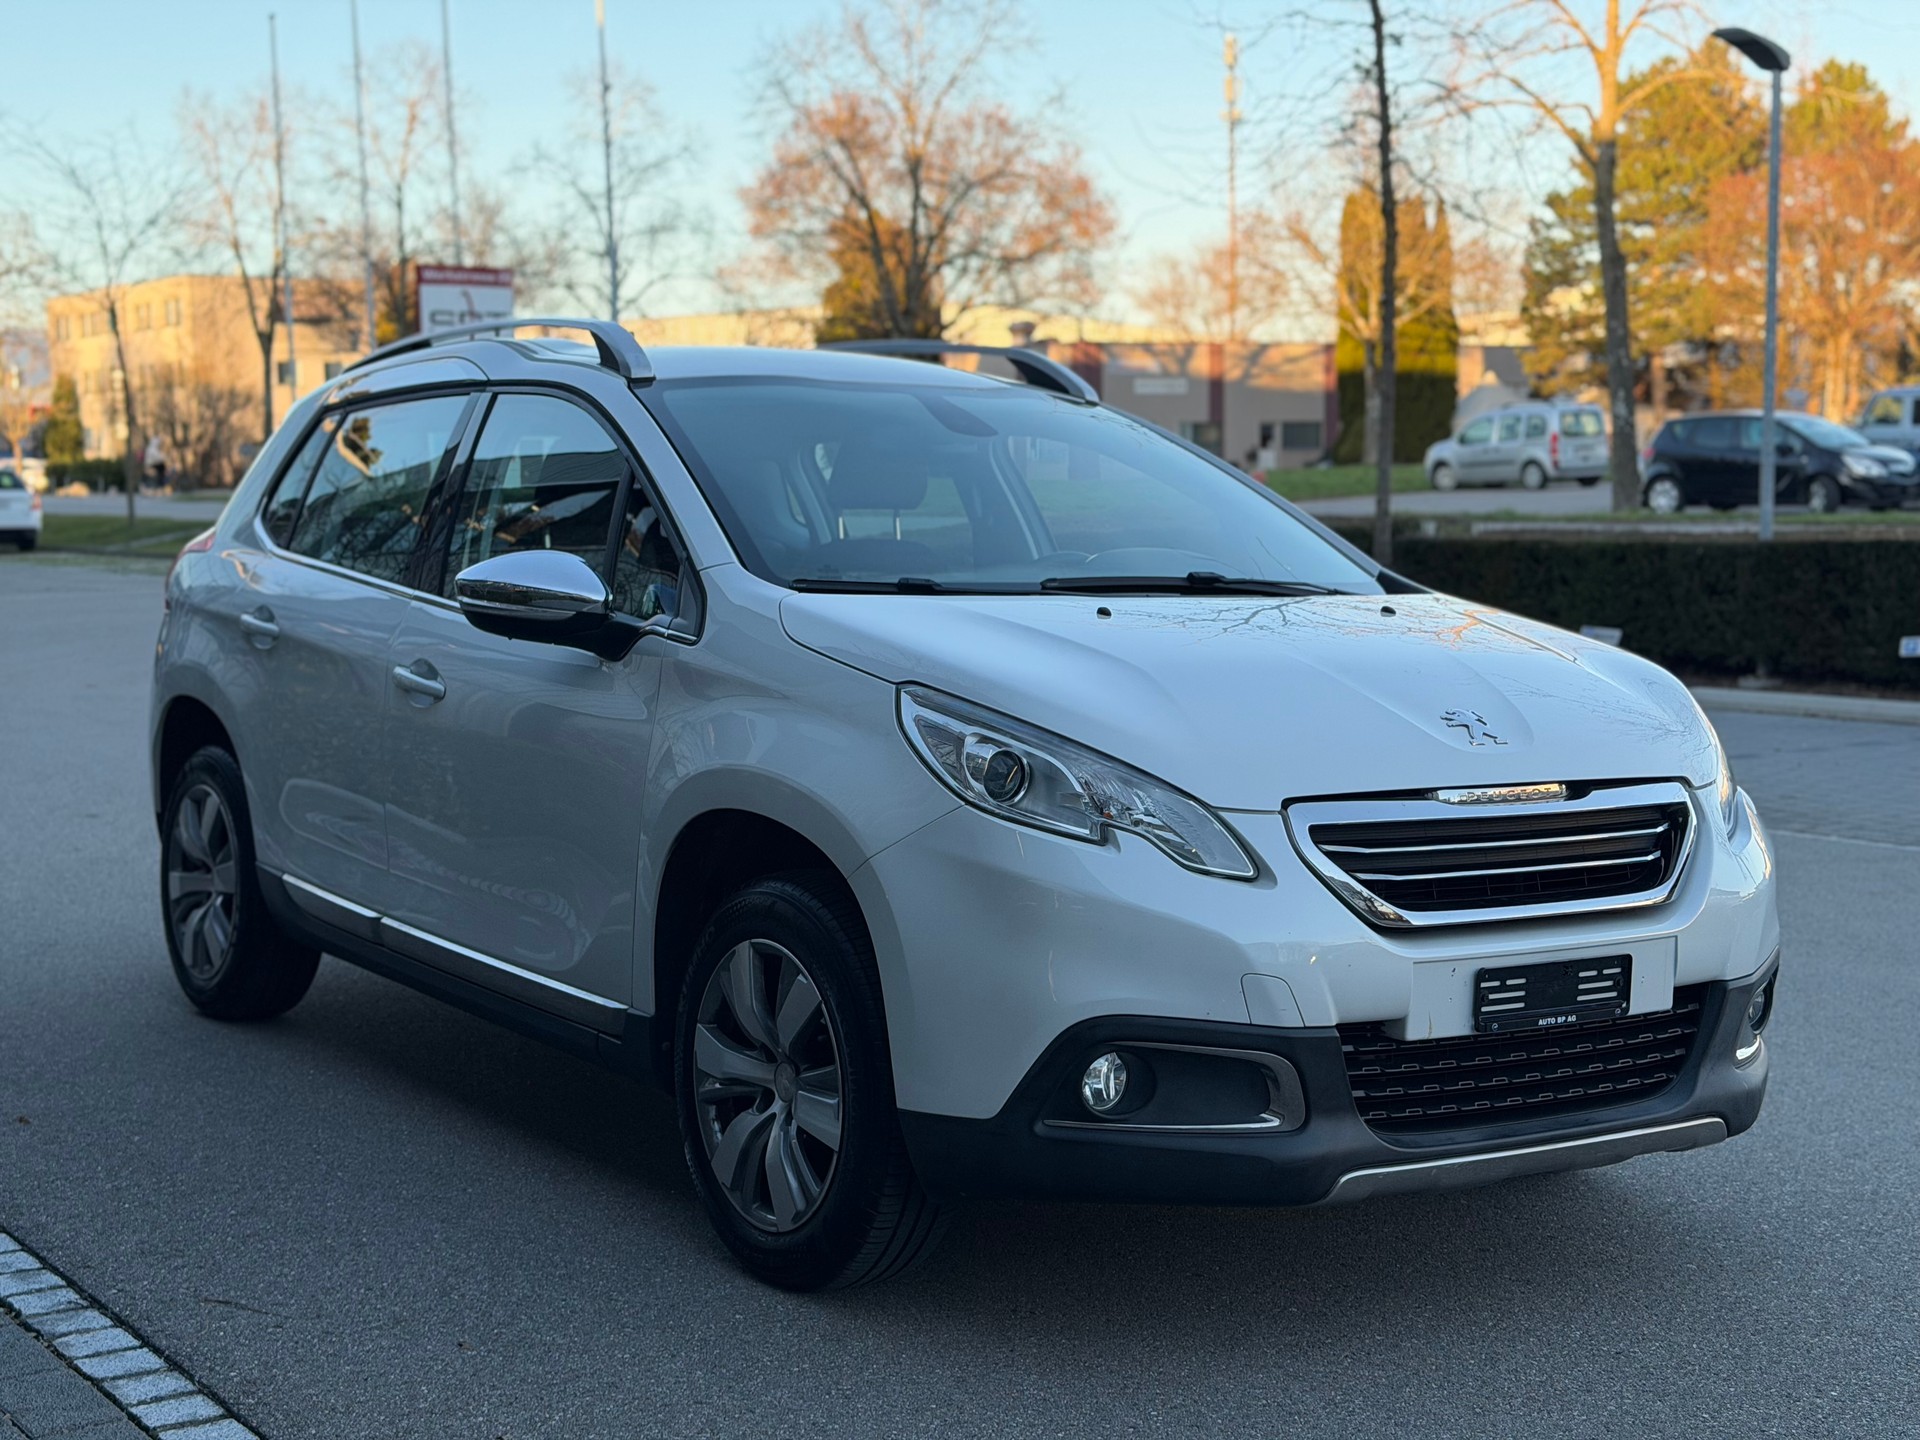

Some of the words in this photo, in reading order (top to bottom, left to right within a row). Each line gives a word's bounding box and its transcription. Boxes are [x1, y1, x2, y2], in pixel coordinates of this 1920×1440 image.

[1466, 786, 1553, 801] PEUGEOT
[1538, 1017, 1556, 1025] AUTO
[1567, 1014, 1577, 1022] AG
